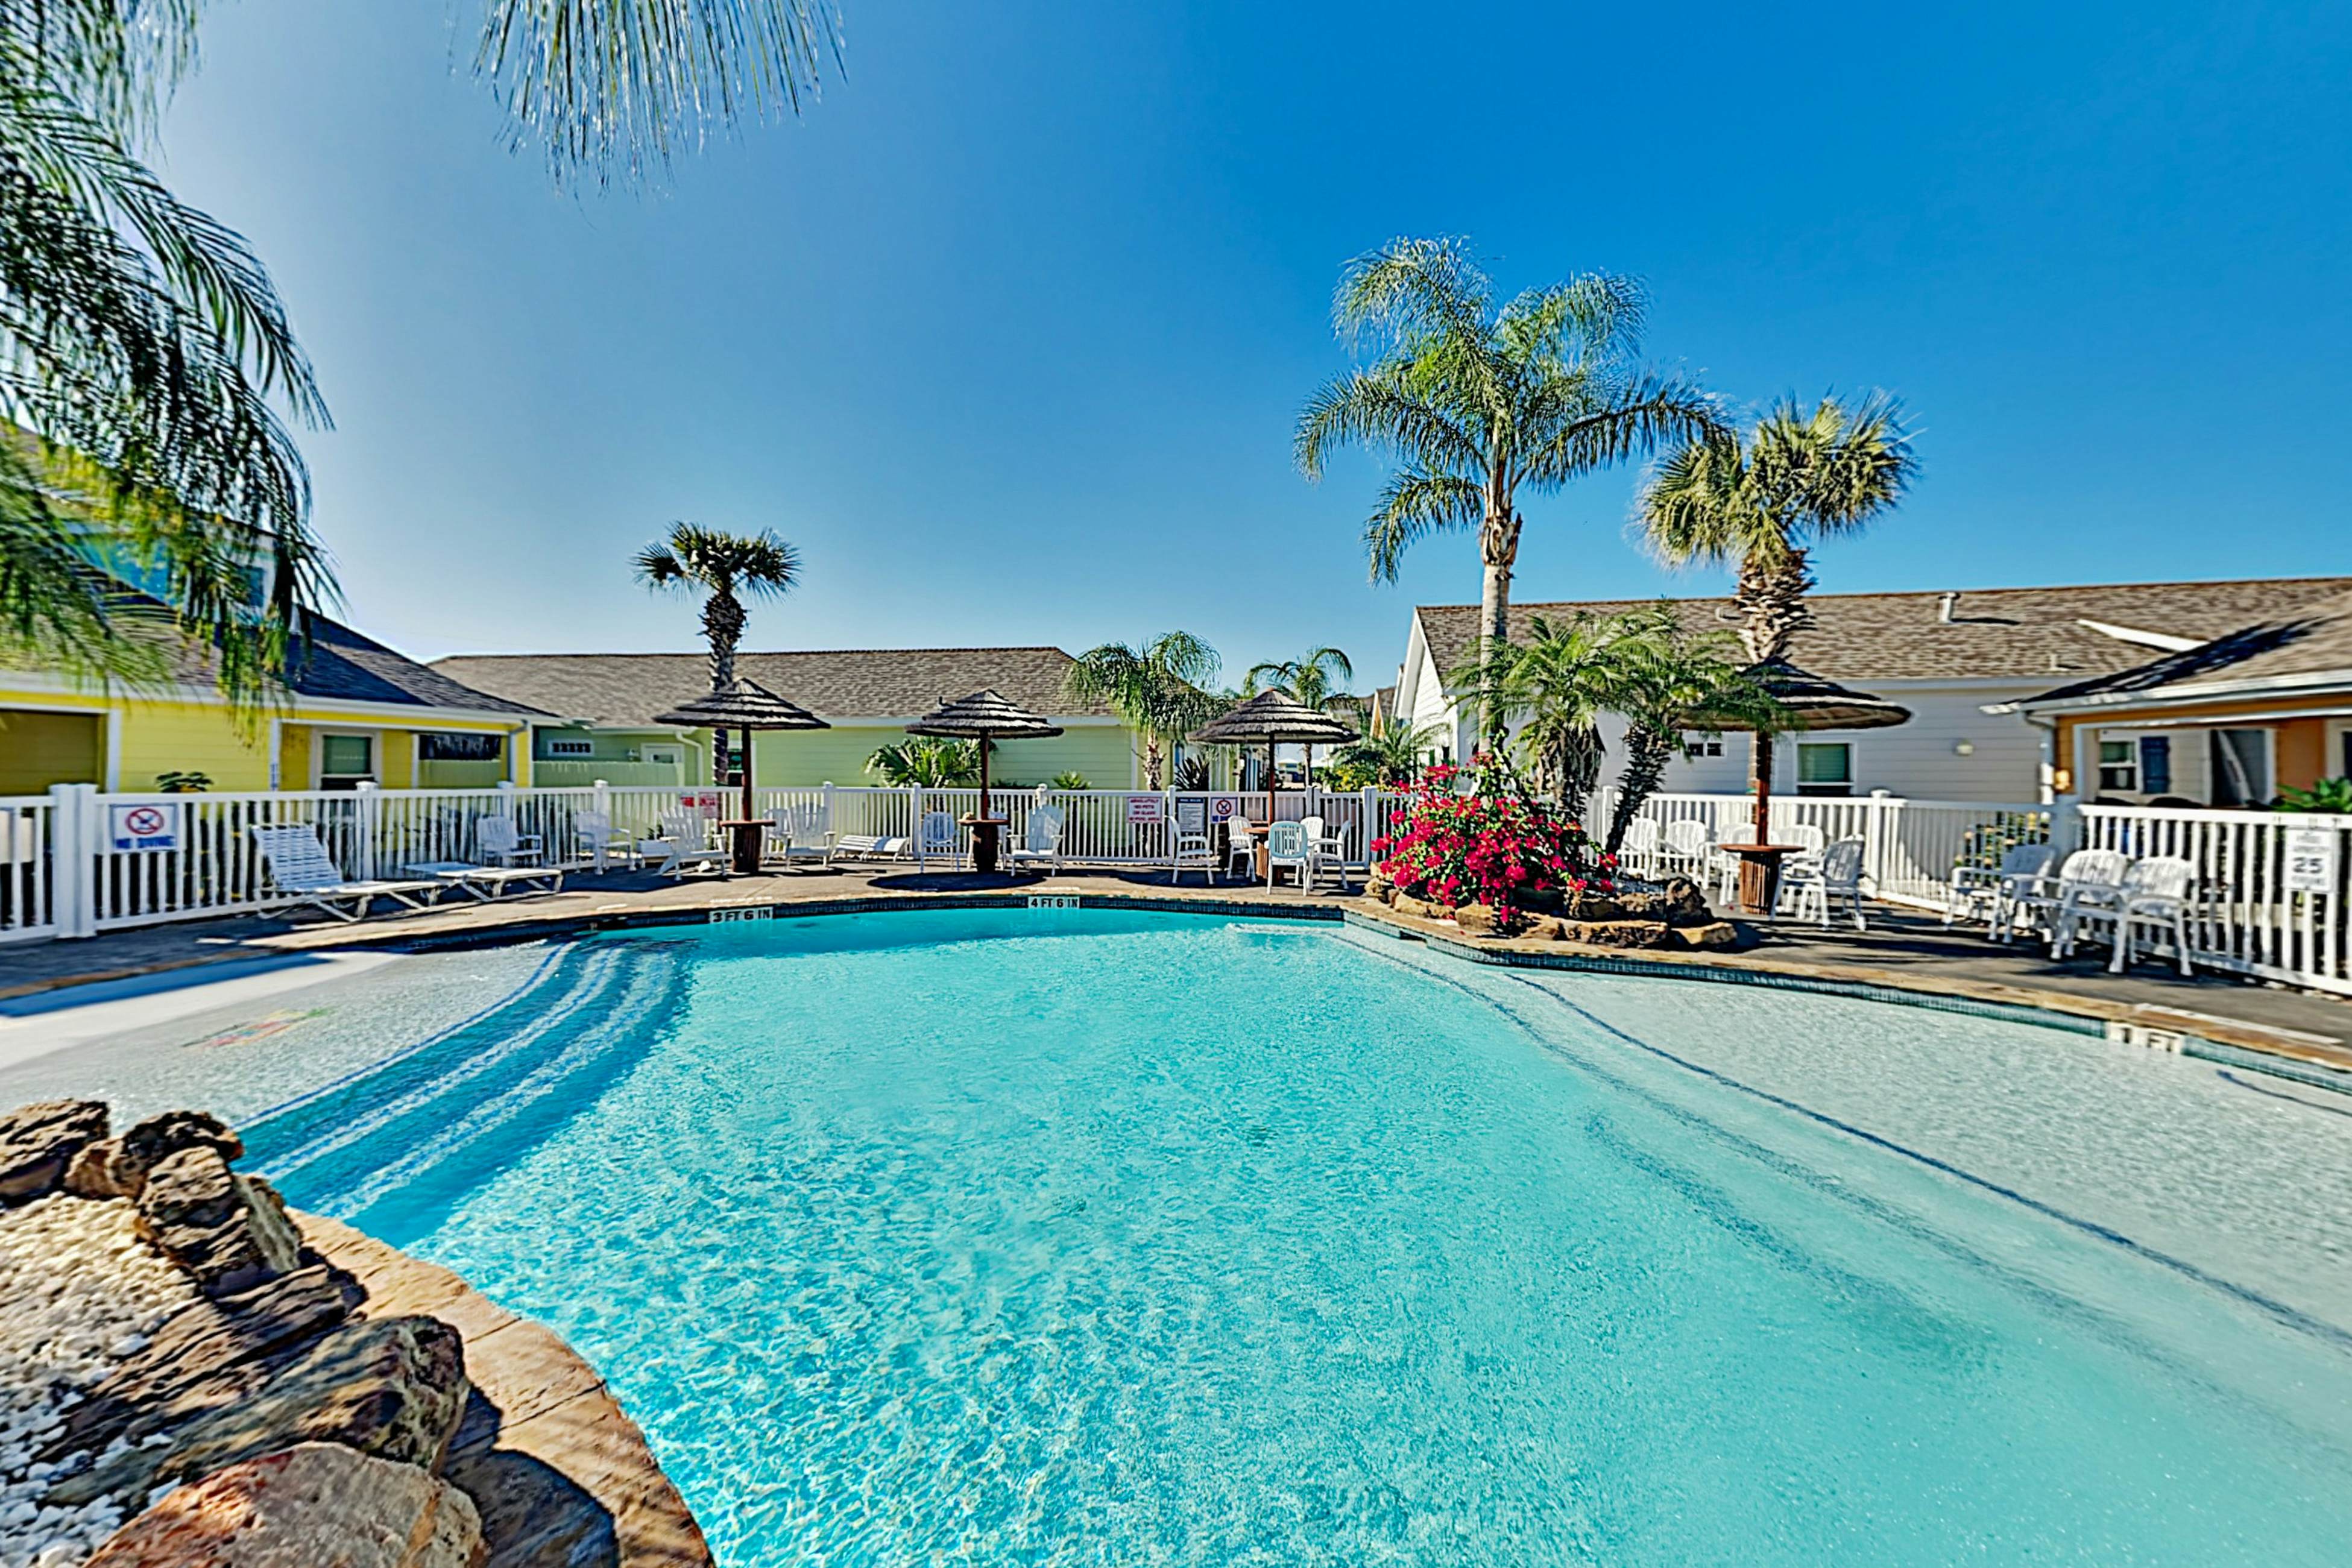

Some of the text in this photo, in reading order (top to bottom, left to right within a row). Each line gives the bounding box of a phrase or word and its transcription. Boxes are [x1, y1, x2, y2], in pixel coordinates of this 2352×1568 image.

[2292, 857, 2324, 875] 25
[1030, 898, 1078, 908] 4 FT 6 IN
[713, 908, 771, 923] 3 FT 6 IN
[2121, 1027, 2178, 1053] 1 FT
